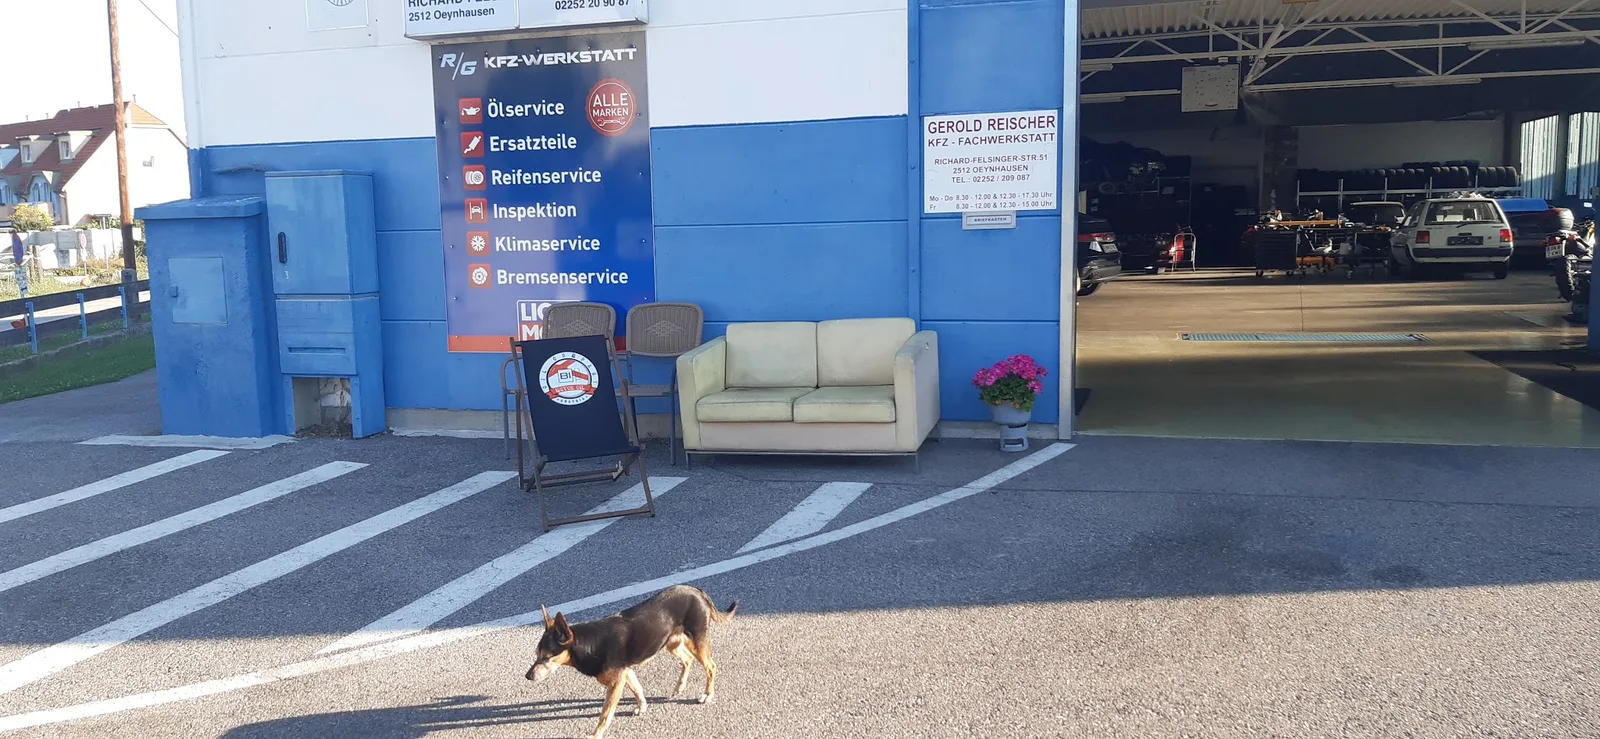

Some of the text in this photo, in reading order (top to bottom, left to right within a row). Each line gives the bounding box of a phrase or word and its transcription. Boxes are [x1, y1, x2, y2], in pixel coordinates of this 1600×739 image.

[555, 0, 585, 10] 02252
[588, 0, 600, 8] 20
[409, 7, 495, 21] 2512 Oeynhausen
[484, 48, 637, 69] KFZ-WERKSTATT
[487, 99, 565, 118] Ölservice
[593, 93, 629, 107] ALLE
[592, 107, 629, 118] MARKEN
[928, 115, 1056, 134] GEROLD REISCHER
[489, 134, 577, 152] Ersatzteile
[928, 138, 949, 147] KFZ
[958, 132, 1055, 146] FACHWERKSTATT
[491, 167, 601, 185] Reifenservice
[973, 164, 1028, 173] OEYNHAUSEN
[973, 175, 995, 183] 02252
[493, 202, 577, 222] Inspektion
[495, 235, 601, 252] Klimaservice
[497, 268, 629, 285] Bremsenservice
